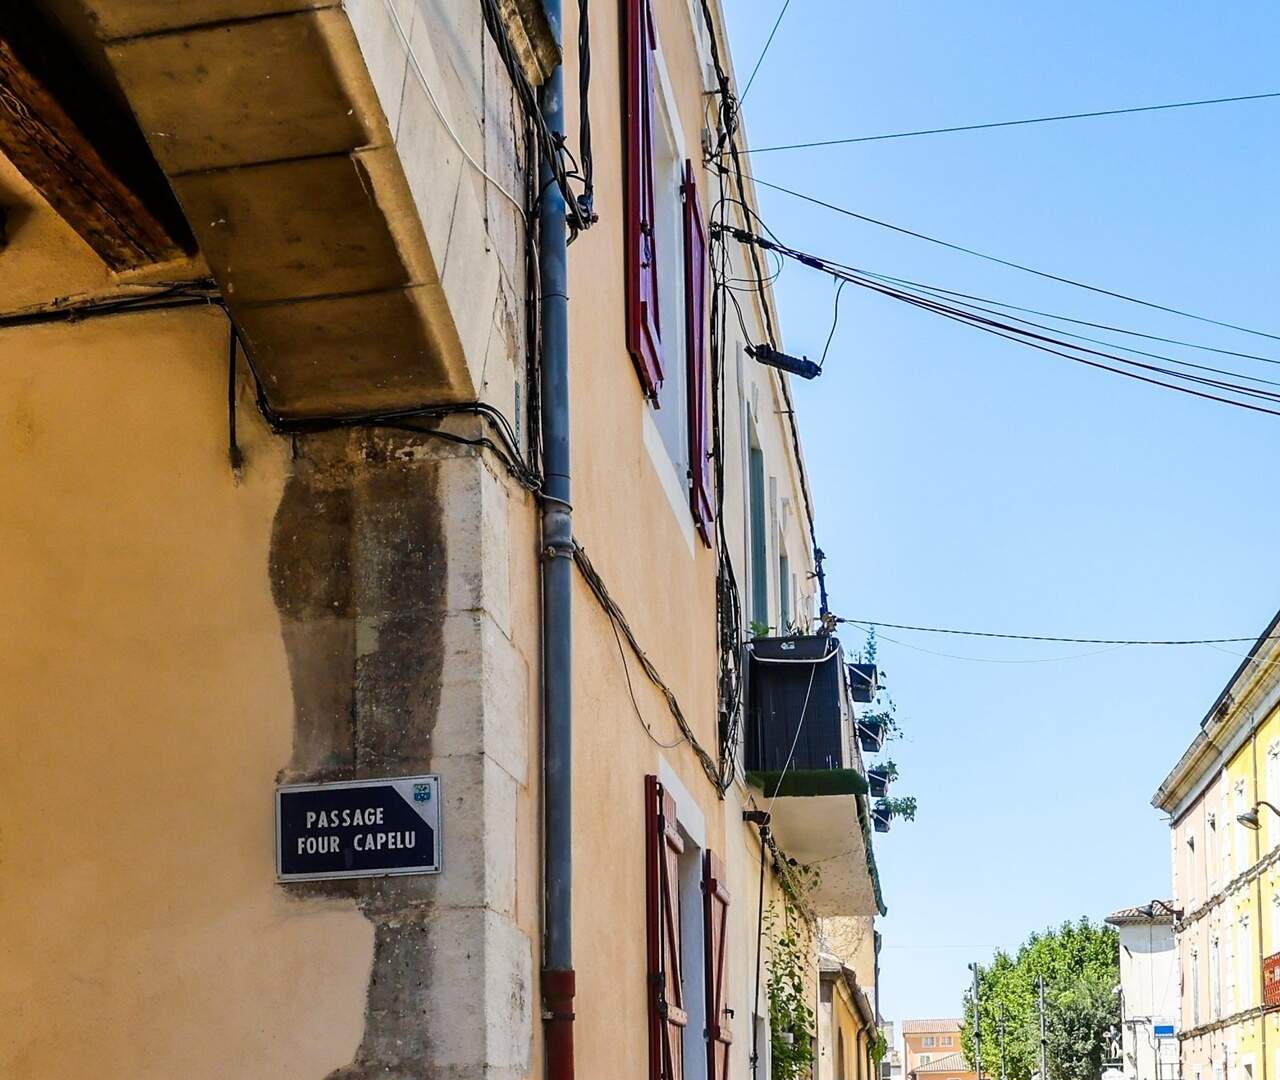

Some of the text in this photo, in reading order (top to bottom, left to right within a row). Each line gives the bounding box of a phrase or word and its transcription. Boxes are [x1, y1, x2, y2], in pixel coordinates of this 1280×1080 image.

[306, 808, 384, 829] PASSAGE
[298, 831, 416, 854] FOUR CAPELU
